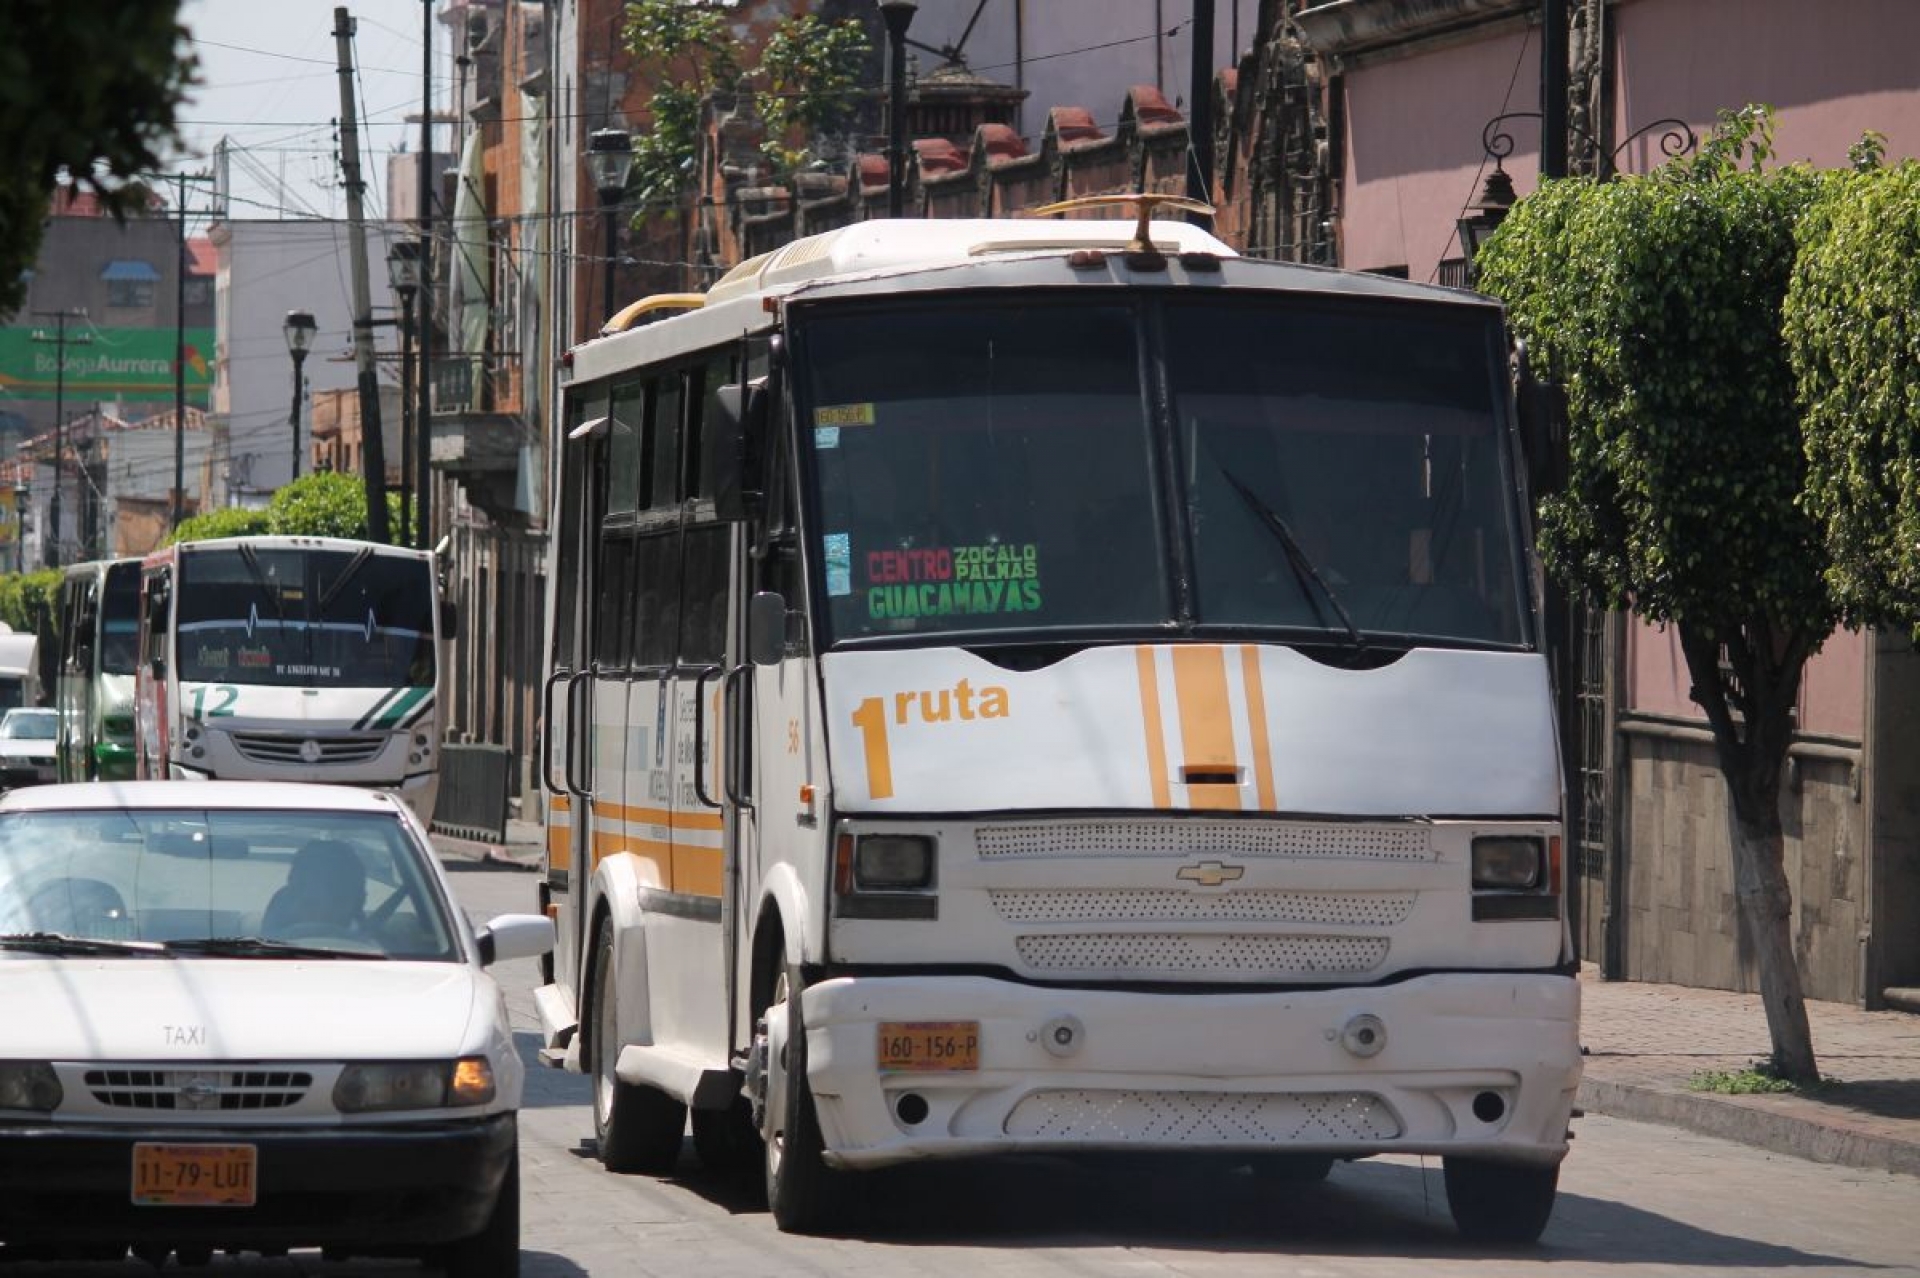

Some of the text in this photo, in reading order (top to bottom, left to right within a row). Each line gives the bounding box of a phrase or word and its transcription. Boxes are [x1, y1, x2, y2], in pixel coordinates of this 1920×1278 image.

[868, 548, 951, 582] CENTRO
[953, 544, 1037, 564] ZOCALO
[956, 562, 1038, 580] PALMAS
[868, 580, 1043, 619] GUACAMAYAS
[189, 685, 239, 720] 12
[852, 678, 1009, 800] 1 ruta
[163, 1026, 206, 1046] TAXI
[882, 1035, 977, 1058] 160-156-P
[141, 1162, 250, 1188] 11-79-LUT
